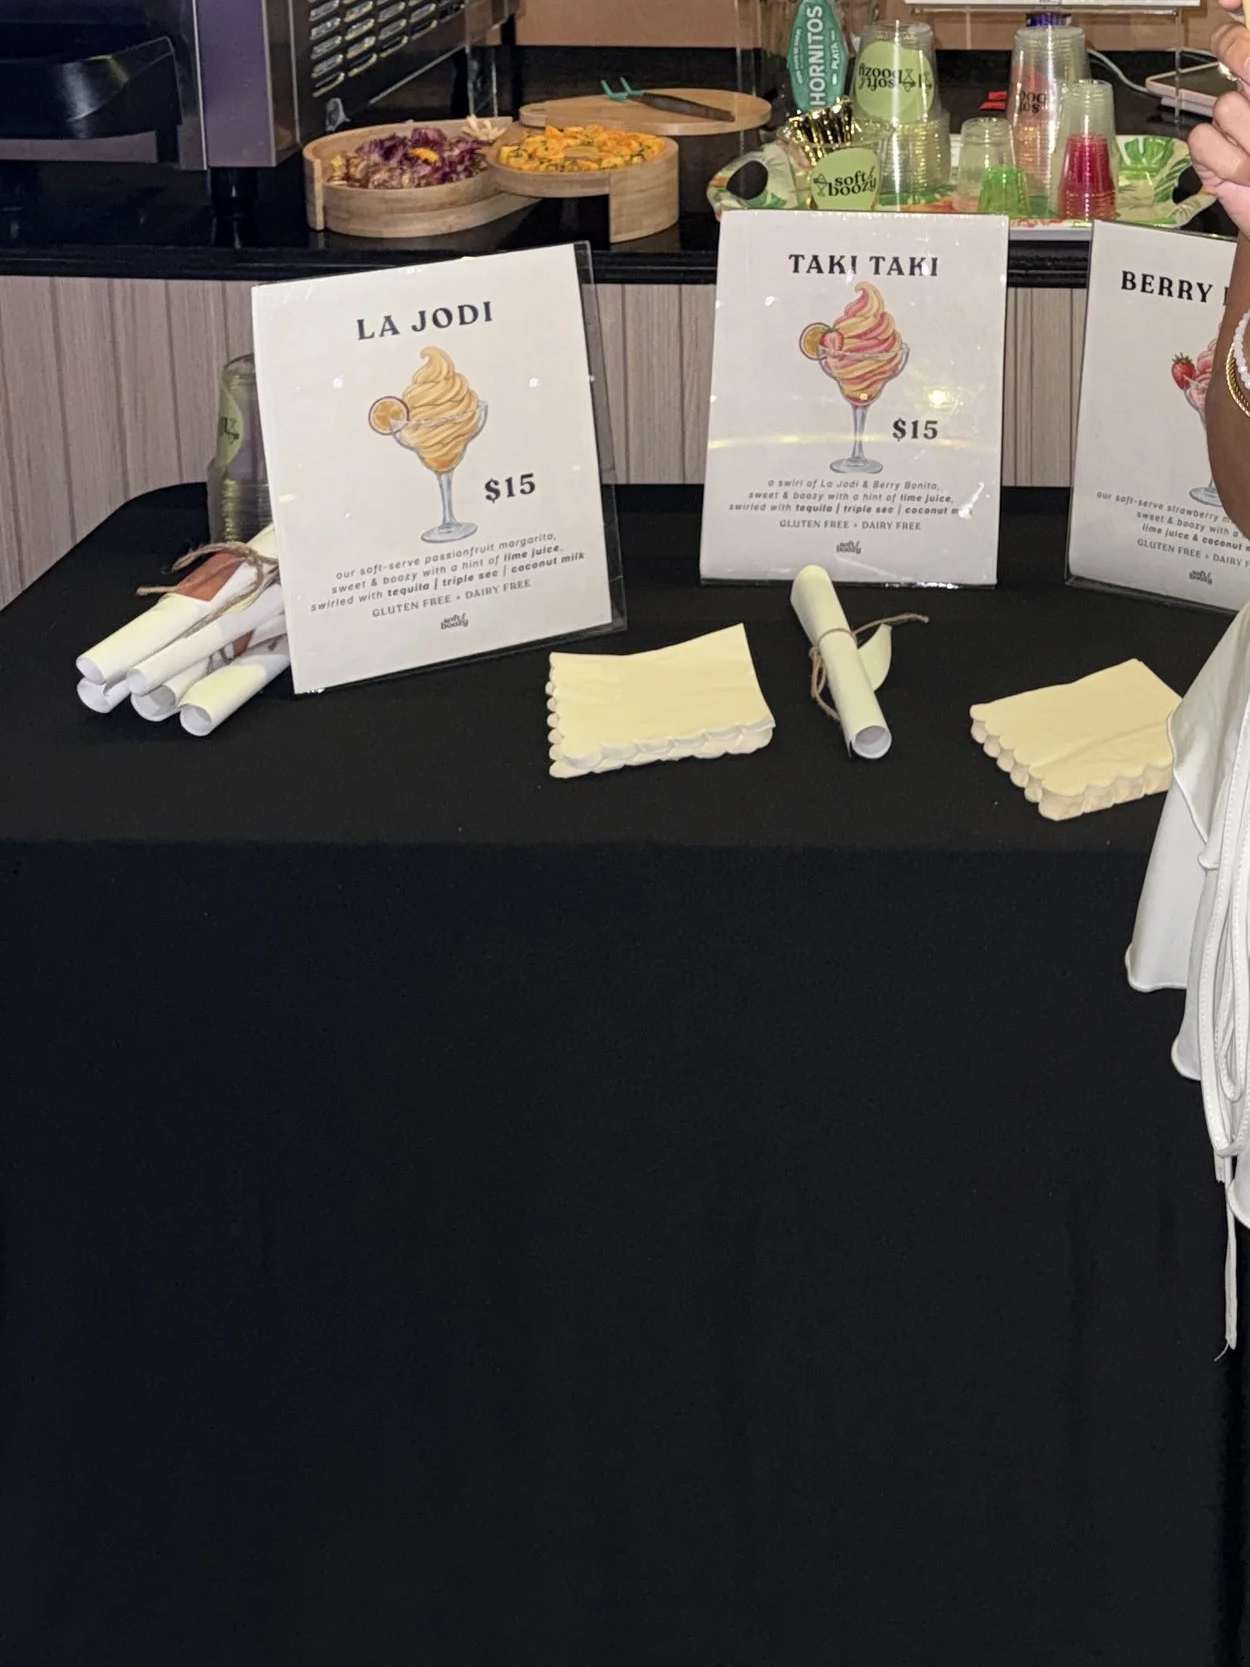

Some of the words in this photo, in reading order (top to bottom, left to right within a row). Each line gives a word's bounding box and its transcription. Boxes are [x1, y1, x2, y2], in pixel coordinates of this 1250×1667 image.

[806, 5, 825, 106] HORNITOS
[831, 42, 840, 70] PLATA
[828, 178, 876, 196] boozy
[835, 170, 866, 186] soft
[788, 254, 858, 276] TAKI
[869, 256, 940, 277] TAKI
[1121, 270, 1213, 303] BERRY
[356, 315, 400, 341] LA
[411, 301, 494, 334] JODI
[892, 418, 939, 442] $15
[484, 473, 536, 504] $15
[749, 491, 779, 499] sweet
[783, 491, 788, 499] &
[793, 492, 823, 501] boozy
[827, 492, 849, 501] with
[863, 493, 883, 502] hint
[886, 493, 897, 503] of
[900, 494, 922, 502] lime
[779, 479, 803, 487] swirl
[807, 479, 818, 489] of
[821, 479, 833, 488] La
[836, 480, 859, 489] Jodi
[862, 480, 869, 489] &
[873, 480, 901, 491] Berry
[729, 503, 766, 511] swirled
[770, 503, 792, 511] with
[795, 504, 833, 514] tequila
[844, 504, 872, 515] triple
[875, 506, 894, 514] sec
[905, 507, 948, 515] coconut
[1097, 491, 1112, 500] our
[1116, 494, 1164, 510] soft-serve
[1167, 505, 1219, 523] strawberry
[780, 520, 821, 529] GLUTEN
[824, 520, 849, 529] FREE
[861, 521, 893, 530] DAIRY
[896, 521, 922, 530] FREE
[1137, 511, 1164, 523] sweet
[1167, 516, 1173, 524] &
[1177, 518, 1206, 532] boozy
[1209, 524, 1230, 535] with
[1142, 523, 1163, 534] lime
[1164, 527, 1189, 540] juice
[1192, 534, 1198, 542] &
[1202, 537, 1243, 550] coconut
[336, 568, 356, 580] our
[360, 557, 420, 577] soft-serve
[424, 543, 495, 565] passionfruit
[1137, 538, 1175, 553] GLUTEN
[1177, 546, 1201, 558] FREE
[1213, 553, 1243, 567] DAIRY
[311, 595, 354, 612] swirled
[359, 590, 383, 603] with
[387, 581, 430, 598] tequila
[442, 573, 474, 587] triple
[478, 568, 499, 579] sec
[511, 558, 558, 574] coconut
[561, 551, 585, 564] milk
[331, 580, 367, 595] sweet
[370, 578, 378, 587] &
[383, 572, 418, 586] boozy
[423, 565, 447, 578] with
[450, 564, 457, 572] a
[462, 558, 484, 571] hint
[488, 555, 500, 569] of
[503, 551, 528, 562] lime
[372, 601, 419, 617] GLUTEN
[423, 594, 451, 607] FREE
[465, 585, 500, 600] DAIRY
[503, 579, 532, 593] FREE
